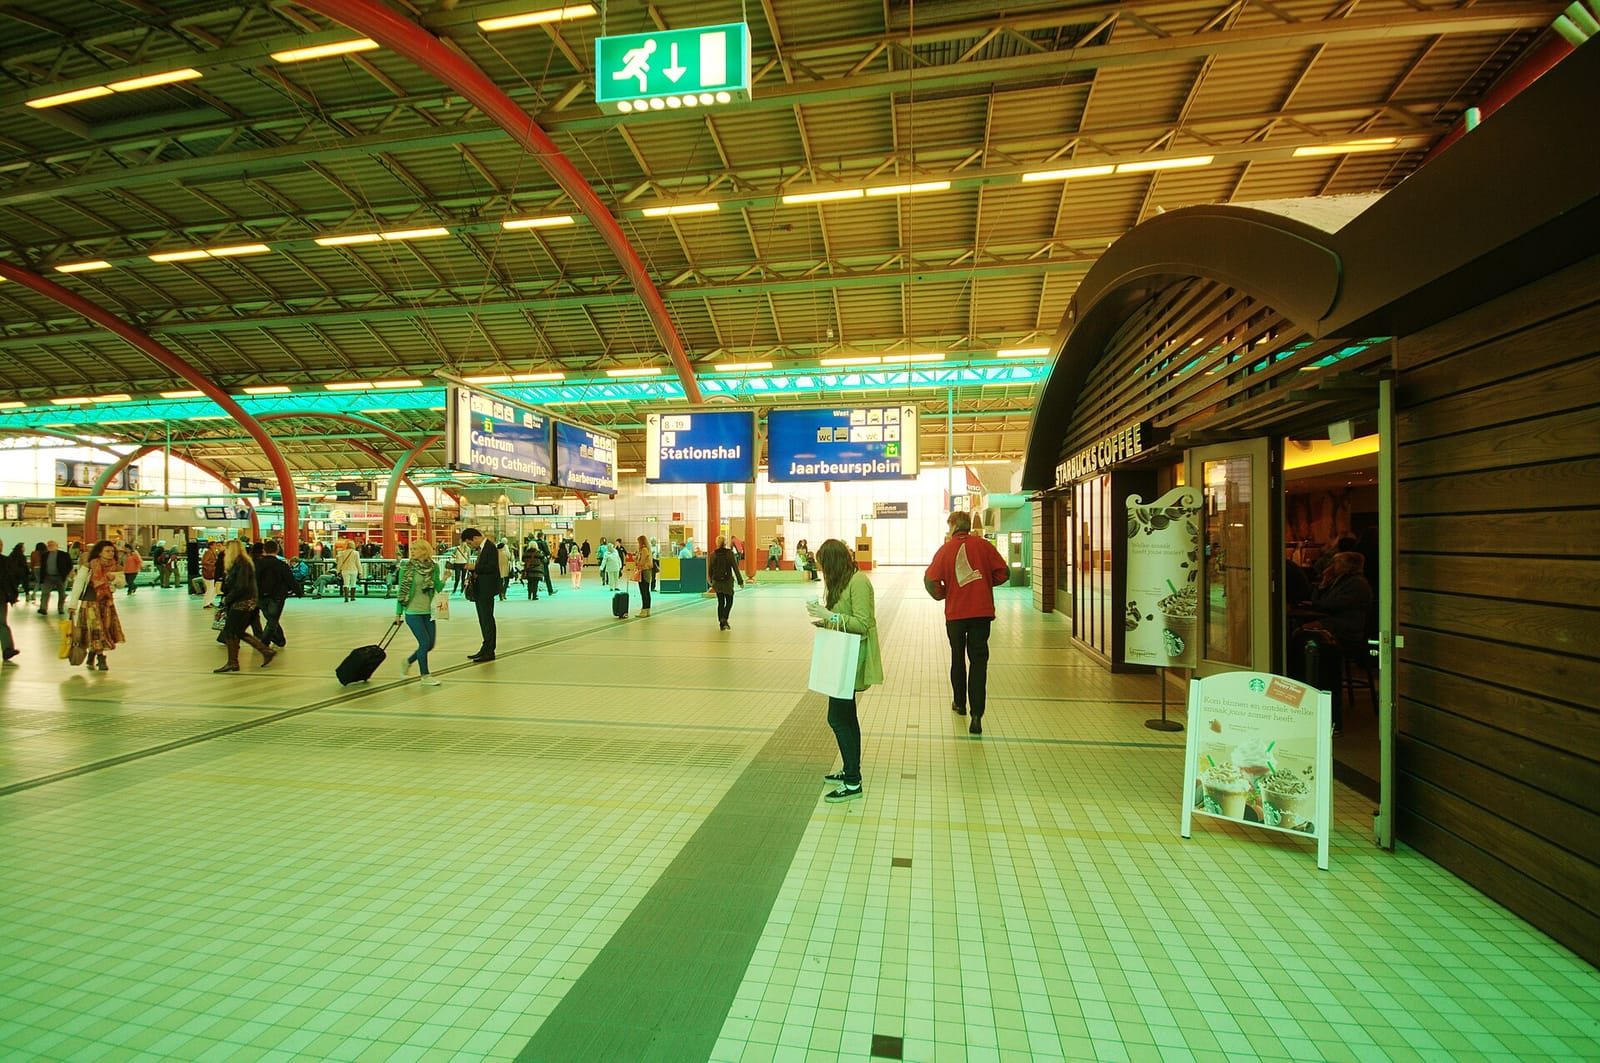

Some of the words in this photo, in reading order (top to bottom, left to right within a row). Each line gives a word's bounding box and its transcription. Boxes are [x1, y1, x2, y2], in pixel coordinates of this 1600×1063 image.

[471, 430, 514, 453] Centrum
[660, 445, 740, 460] Stationshal
[1055, 446, 1097, 486] STARBUCKS
[1097, 422, 1142, 468] COFFEE
[471, 449, 498, 470] Hoog
[501, 456, 546, 478] Catharijne
[789, 459, 900, 476] Jaarbeursplein
[568, 470, 613, 489] Jaarbeursplein
[1203, 706, 1228, 714] smaak
[1204, 696, 1221, 705] Kom
[1223, 698, 1249, 708] binnen
[1262, 704, 1288, 713] ontdek
[1290, 707, 1314, 716] welke
